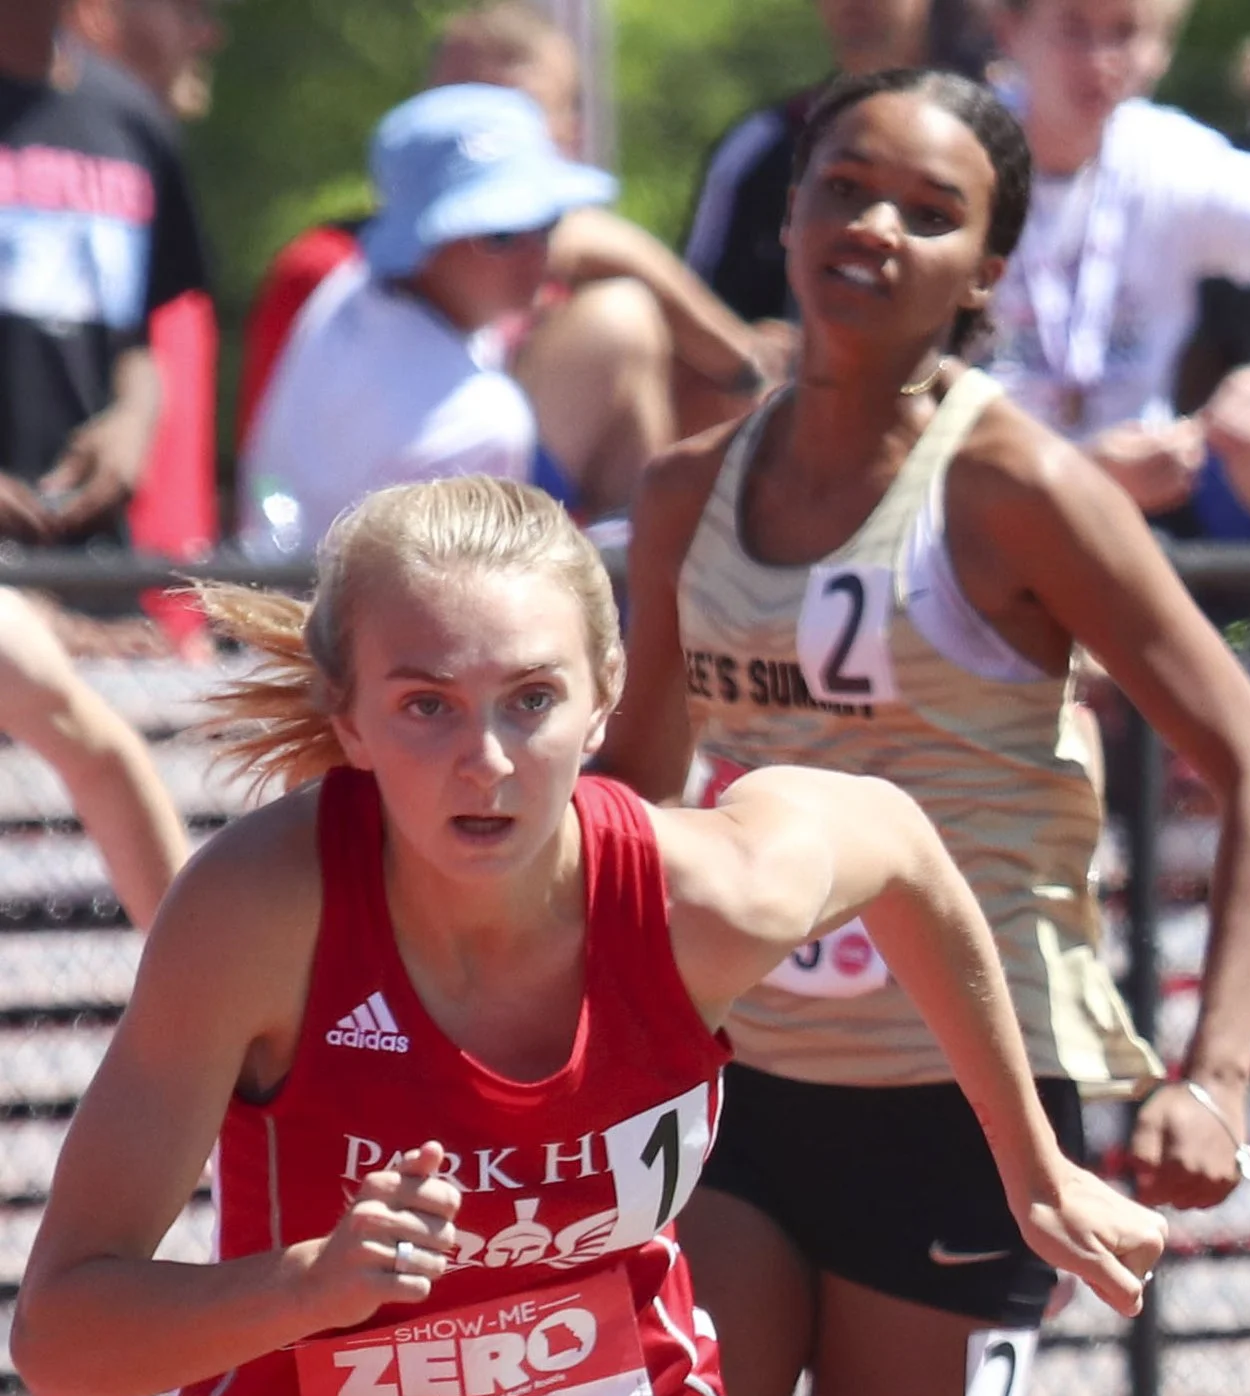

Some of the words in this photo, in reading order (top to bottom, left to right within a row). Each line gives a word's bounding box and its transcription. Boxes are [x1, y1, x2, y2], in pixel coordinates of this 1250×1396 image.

[822, 573, 872, 694] 2
[326, 1027, 410, 1054] adidas
[639, 1108, 681, 1233] 1
[394, 1300, 538, 1342] SHOW-ME
